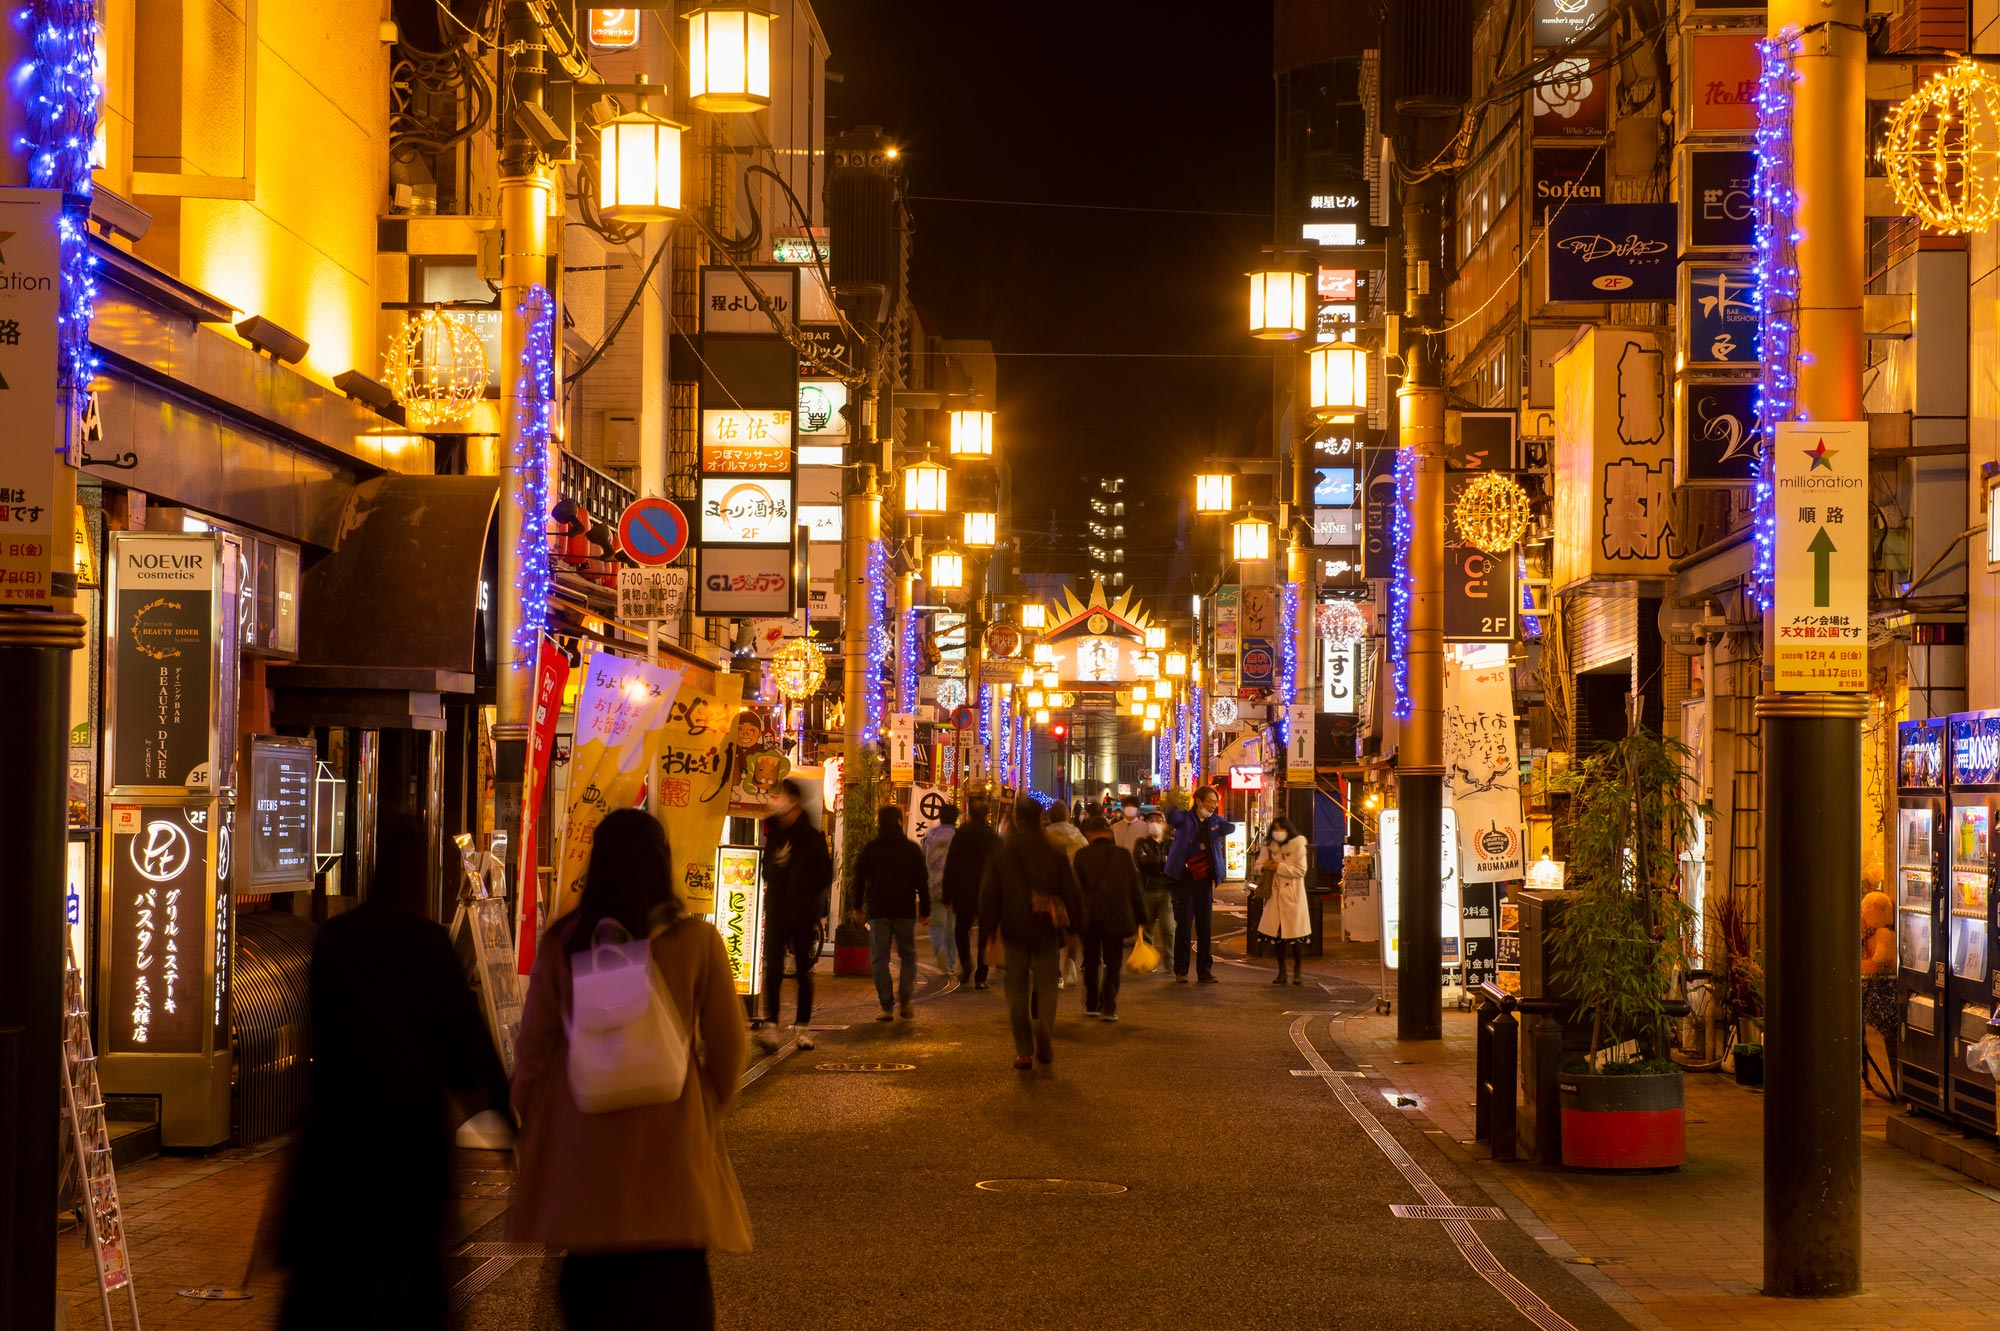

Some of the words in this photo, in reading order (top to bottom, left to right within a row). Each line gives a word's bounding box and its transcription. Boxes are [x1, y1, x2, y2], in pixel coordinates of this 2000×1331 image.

[1537, 180, 1601, 198] Soften
[1604, 278, 1623, 288] 2F
[772, 413, 790, 425] 3F
[712, 450, 784, 460] つぼマッサージ
[707, 461, 789, 472] オイルマッサージ
[1780, 475, 1863, 488] millionation
[705, 499, 788, 519] まつり酒場
[1798, 506, 1844, 524] 順路
[741, 528, 760, 539] 2F
[129, 554, 203, 569] NOEVIR
[137, 570, 195, 580] cosmetics
[1481, 618, 1507, 633] 2F
[1792, 615, 1850, 626] メイン会場は
[1780, 626, 1862, 638] 天文館公園です
[159, 666, 168, 725] BEAUTY
[157, 730, 168, 779] DINER
[1968, 735, 1992, 770] BOSS
[192, 771, 208, 783] 3F
[661, 742, 734, 803] おにぎり
[190, 811, 207, 824] 2F
[131, 976, 151, 1044] 天文館店
